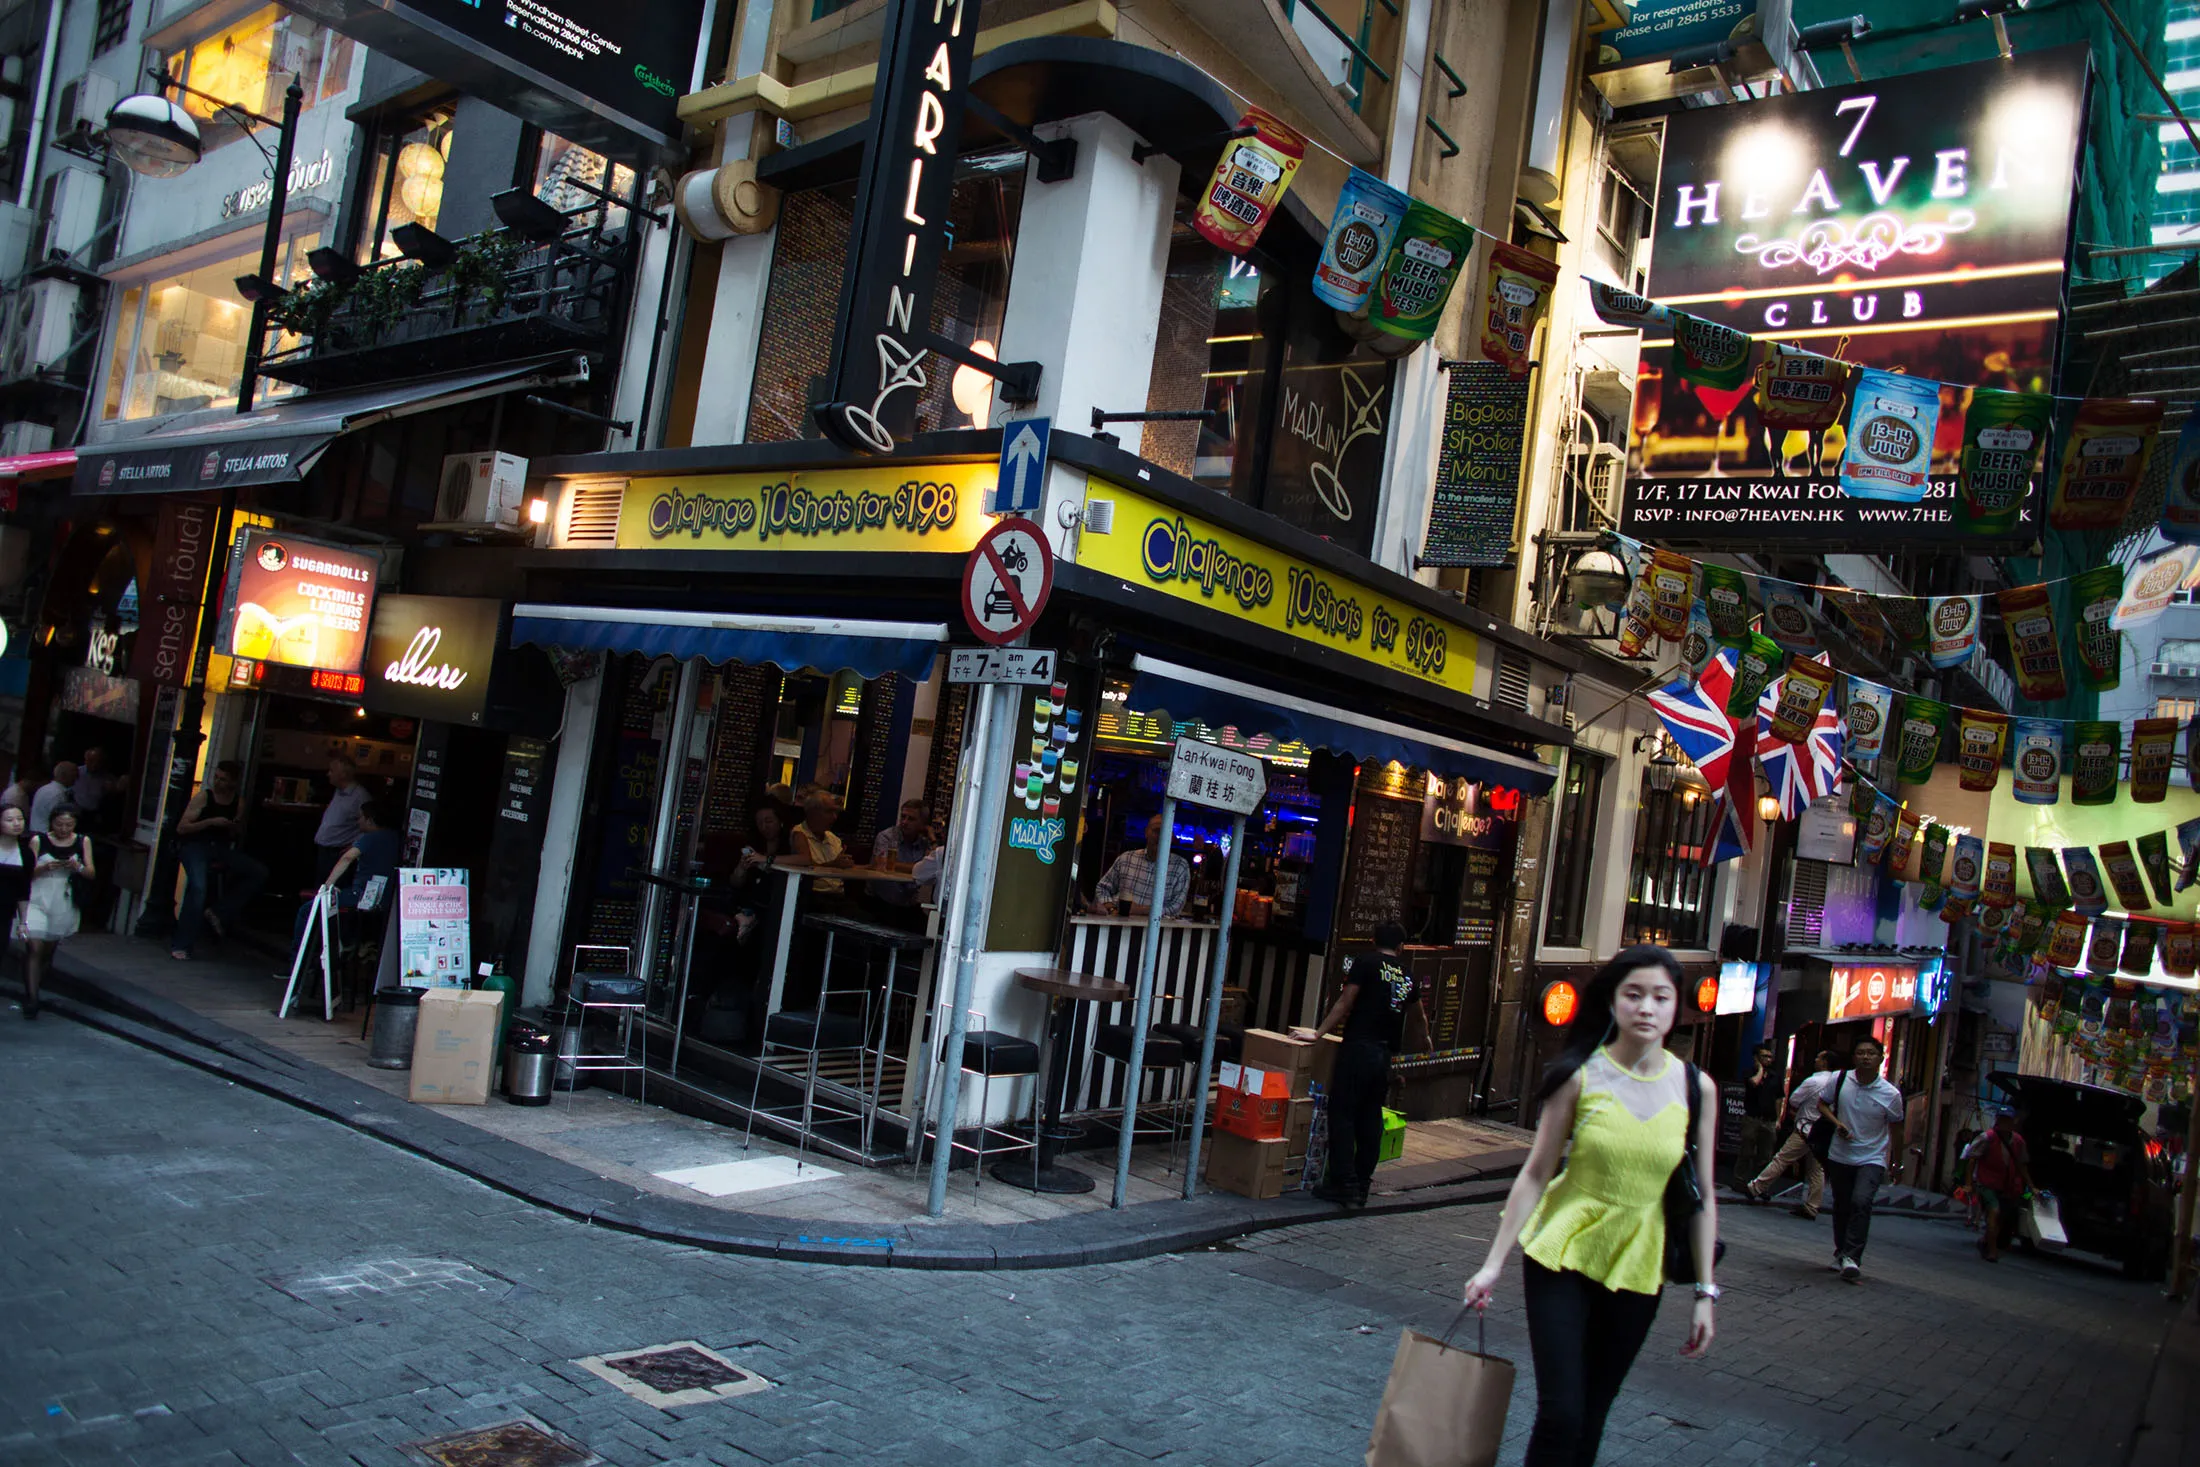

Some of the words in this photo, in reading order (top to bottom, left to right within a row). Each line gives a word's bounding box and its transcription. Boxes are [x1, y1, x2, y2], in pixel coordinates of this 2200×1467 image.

[506, 0, 560, 34] Reservations
[560, 28, 581, 45] 2868
[580, 39, 600, 55] 6026
[1615, 25, 1651, 42] please
[1654, 18, 1674, 32] call
[1677, 12, 1708, 27] 2845
[1710, 4, 1742, 20] 5533
[1632, 12, 1650, 23] For
[522, 22, 585, 60] fb.com/pulphk
[564, 19, 591, 39] Street,
[592, 33, 622, 55] Central
[634, 64, 675, 97] Carlsberg
[1835, 95, 1877, 157] 7
[886, 0, 964, 334] MARLIN
[221, 181, 269, 218] sense
[287, 150, 333, 195] ouch
[1231, 170, 1267, 198] 音樂
[1212, 184, 1262, 225] 啤酒節
[1402, 257, 1439, 285] BEER
[1389, 274, 1438, 301] MUSIC
[1391, 295, 1422, 315] FEST
[1611, 295, 1645, 312] JULY
[1764, 292, 1923, 327] CLUB
[1691, 320, 1732, 342] BEER
[1685, 334, 1737, 355] MUSIC
[1694, 349, 1725, 367] FEST
[1784, 358, 1826, 377] 音樂
[1770, 380, 1832, 402] 啤酒節
[1281, 386, 1340, 457] MARLIN
[1452, 402, 1520, 426] Biggest
[1449, 429, 1518, 454] Shooter
[1871, 422, 1913, 446] 13-14
[1868, 439, 1910, 460] JULY
[1980, 451, 2022, 471] BEER
[119, 465, 145, 480] STELLA
[146, 463, 172, 479] ARTOIS
[223, 457, 253, 472] STELLA
[254, 452, 289, 469] ARTOIS
[1451, 459, 1507, 483] Menu
[1636, 484, 1671, 502] 1/F,
[1677, 485, 1699, 500] 17
[1808, 483, 1850, 500] FON
[1922, 481, 1956, 498] 281
[1970, 470, 2026, 490] MUSIC
[649, 487, 756, 538] Challenge
[855, 488, 888, 531] for
[892, 481, 957, 535] $198
[1448, 492, 1462, 502] the
[1463, 493, 1496, 504] smallest
[1497, 494, 1512, 505] bar
[1977, 491, 2012, 507] FEST
[1634, 508, 1673, 522] RSVP
[1859, 508, 1953, 522] WWW.7HE
[171, 505, 206, 583] touch
[292, 556, 369, 583] SUGARDOLLS
[1142, 517, 1274, 610] Challenge
[1369, 604, 1400, 653] for
[1405, 614, 1447, 676] $198
[1939, 602, 1967, 620] 13-14
[1938, 618, 1965, 632] JULY
[2089, 620, 2115, 637] BEE
[86, 629, 119, 677] Keg
[153, 604, 186, 681] sense
[384, 626, 469, 690] allure
[956, 654, 970, 663] pm
[1007, 653, 1024, 662] am
[1030, 655, 1049, 679] 4
[2095, 655, 2113, 669] FES
[319, 671, 343, 690] SHOTS
[952, 666, 972, 678] 下午
[1002, 666, 1027, 679] 上午
[1176, 744, 1200, 765] Lan
[1200, 750, 1228, 771] Kwai
[1230, 758, 1256, 782] Fong
[2026, 754, 2050, 765] 13-14
[2026, 765, 2050, 777] JULY
[2080, 757, 2106, 769] BEER
[1188, 774, 1237, 804] 蘭桂坊
[1434, 806, 1493, 837] Challenge?
[1012, 823, 1048, 847] MARLIN
[1728, 1106, 1748, 1116] HOU
